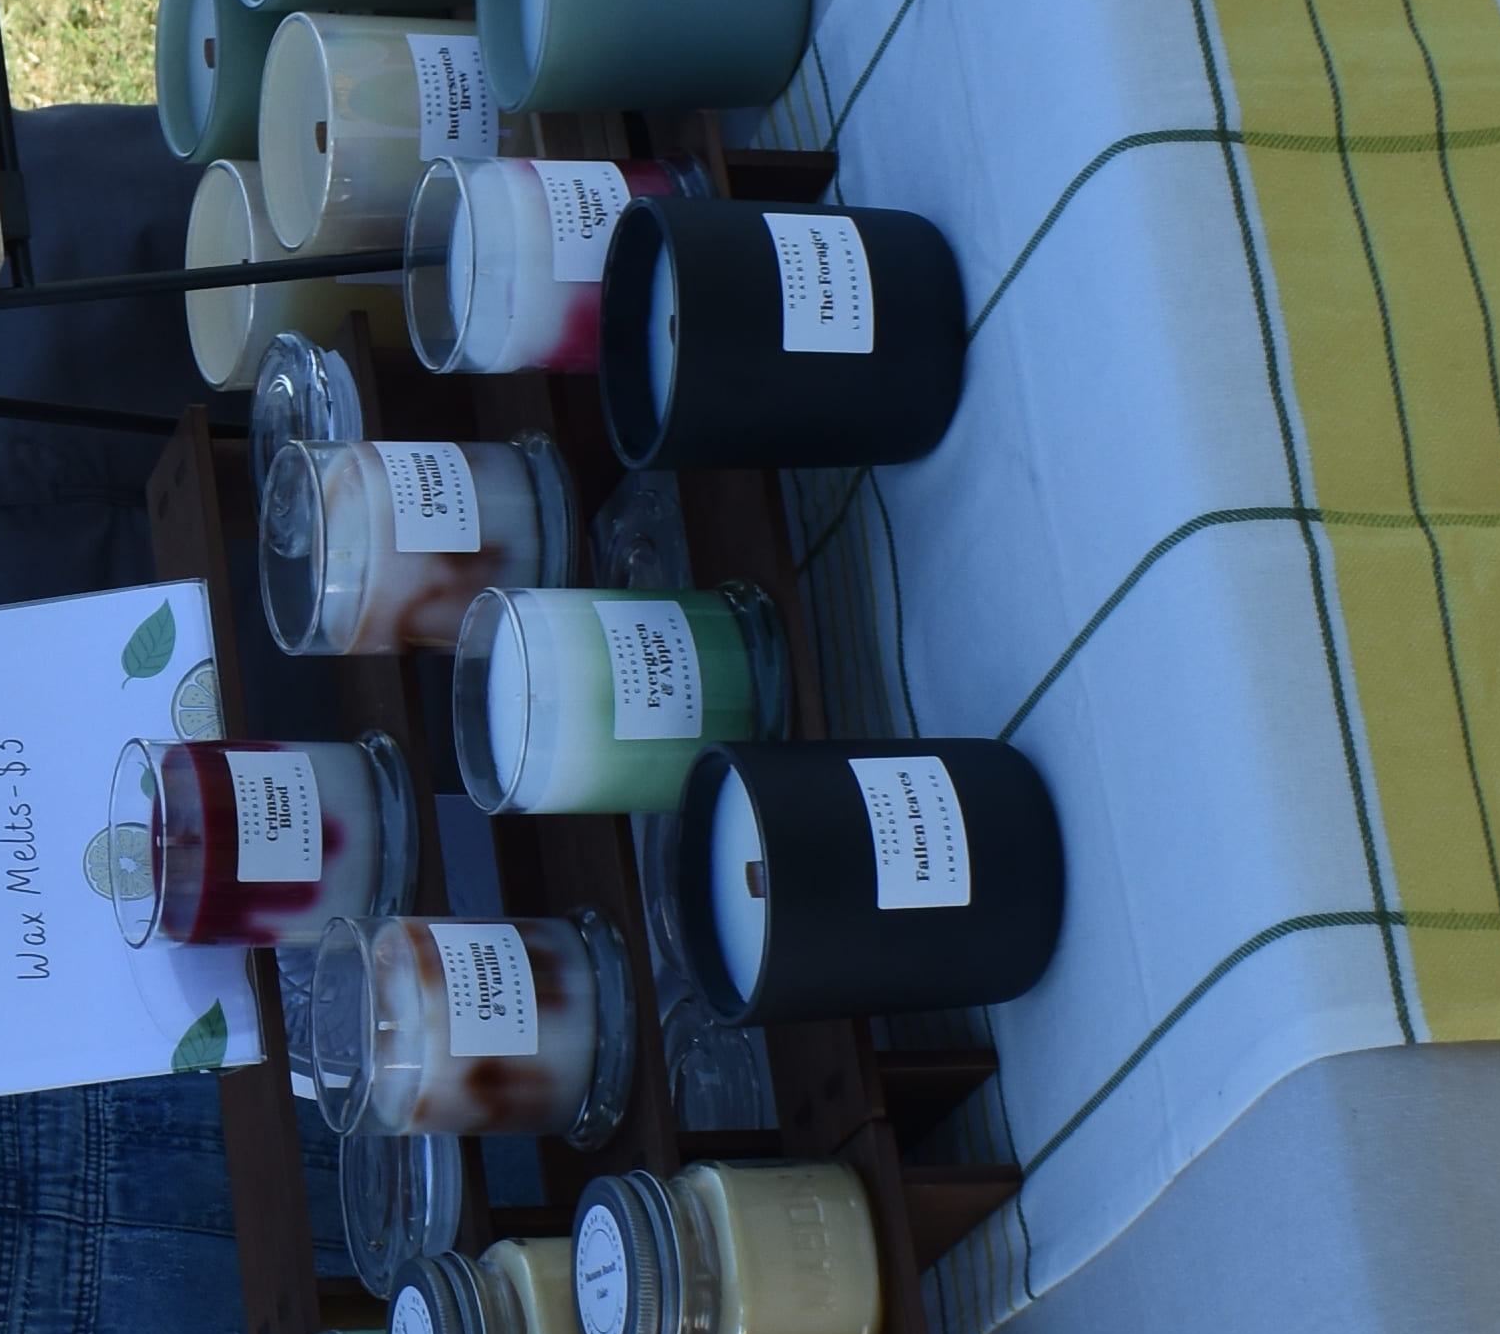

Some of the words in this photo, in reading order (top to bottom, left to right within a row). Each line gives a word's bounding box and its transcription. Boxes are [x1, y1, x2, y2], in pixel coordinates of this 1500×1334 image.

[437, 47, 460, 140] Butterscotch
[458, 71, 472, 111] Brew
[571, 178, 593, 240] Crimson
[588, 188, 608, 227] Spice
[808, 228, 833, 286] Forager
[819, 290, 835, 325] The
[409, 452, 434, 518] Cinnamon
[424, 454, 445, 498] Vanilla
[433, 501, 448, 515] &
[634, 623, 661, 709] Evergreen
[650, 630, 674, 679] Apple
[659, 681, 674, 697] &
[262, 776, 278, 842] Crimson
[276, 786, 292, 829] Blood
[896, 771, 922, 819] leaves
[911, 824, 930, 883] Fallen
[16, 913, 50, 979] Wax
[483, 945, 504, 998] Vanilla
[468, 942, 492, 1021] Cinnamon
[491, 1002, 507, 1017] &
